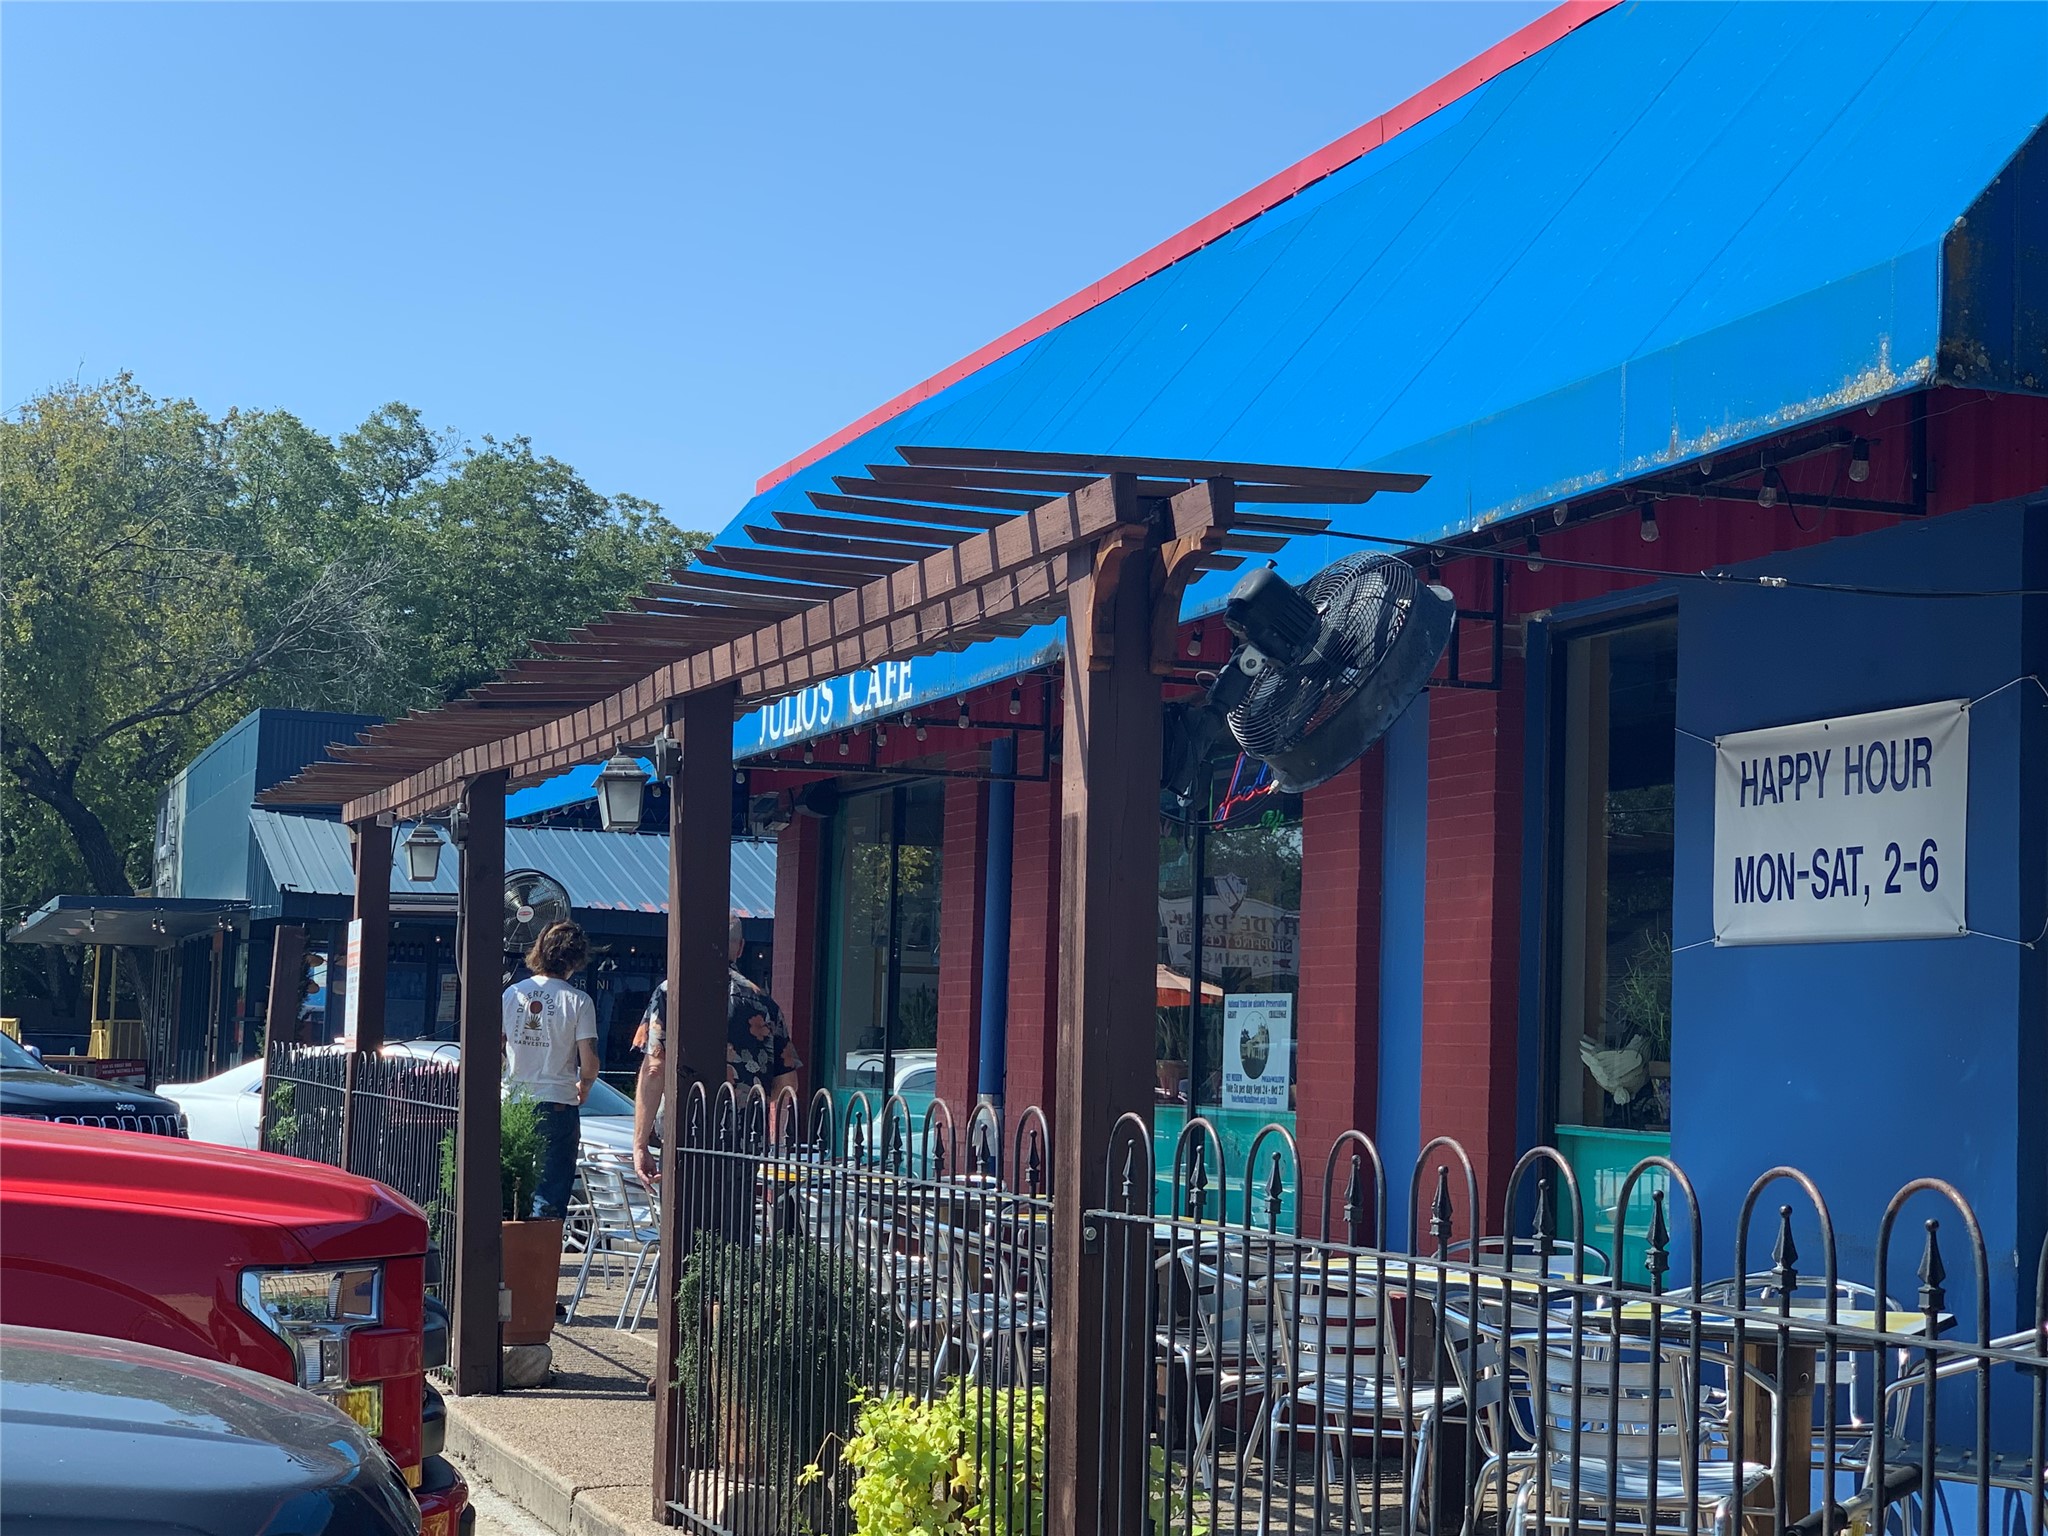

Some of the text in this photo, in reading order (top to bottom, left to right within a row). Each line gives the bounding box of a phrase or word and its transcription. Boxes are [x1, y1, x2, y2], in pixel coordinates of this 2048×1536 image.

[759, 680, 834, 746] JULIO'S
[1740, 736, 1933, 808] HAPPY HOUR
[1734, 838, 1939, 907] MON-SAT, 2-6
[116, 1102, 136, 1113] Jeep
